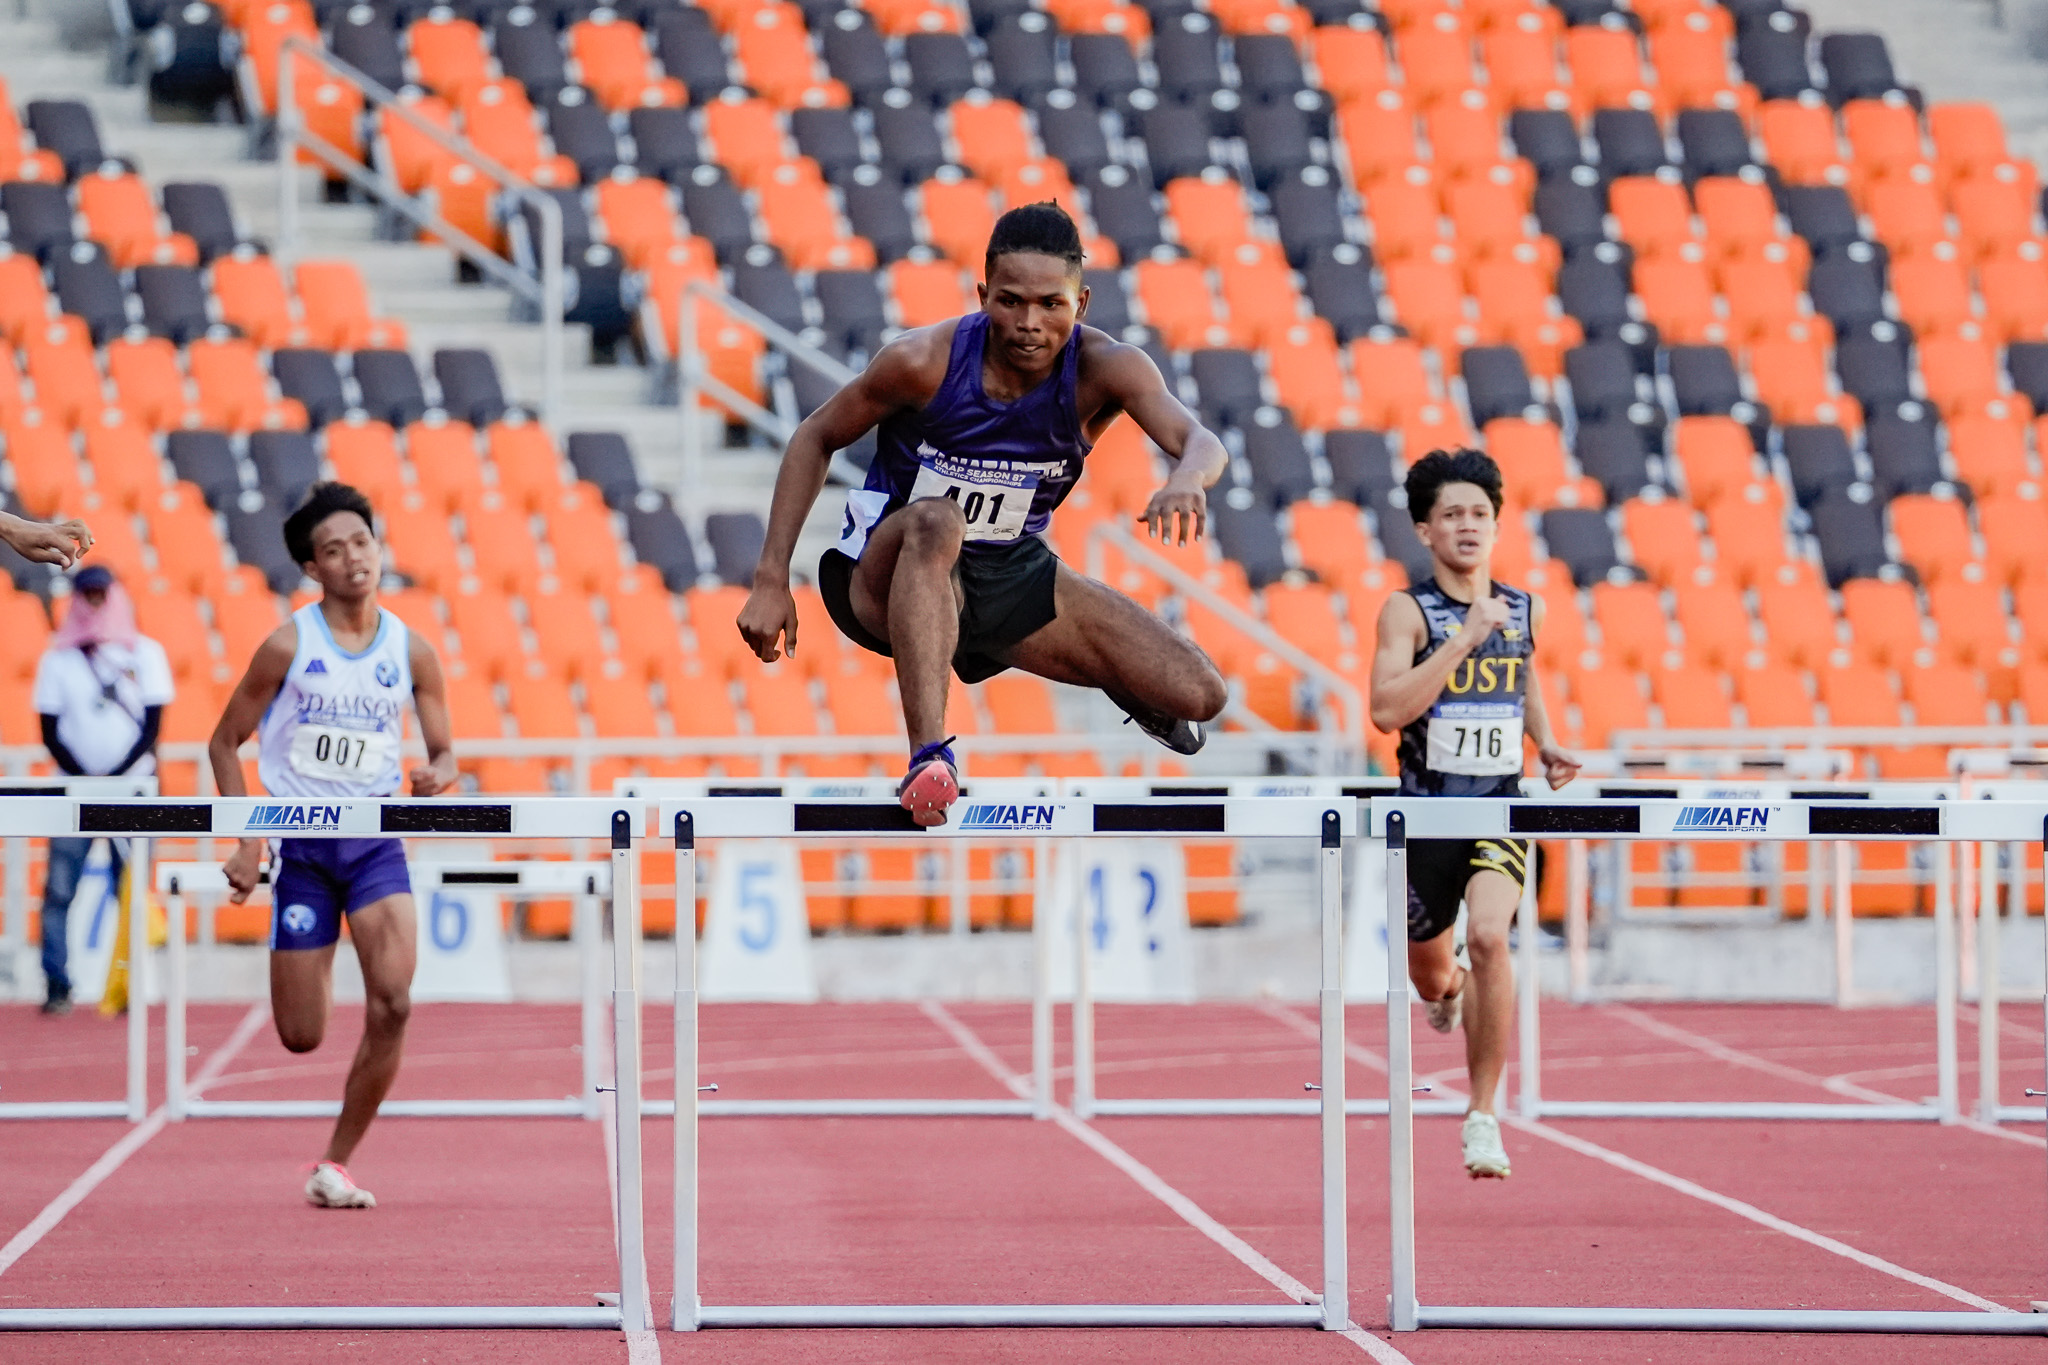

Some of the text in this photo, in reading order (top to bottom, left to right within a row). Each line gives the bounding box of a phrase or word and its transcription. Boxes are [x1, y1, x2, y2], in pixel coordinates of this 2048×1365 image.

[933, 465, 1022, 487] ATHLETICS CHAMPIONSHIPS
[934, 458, 1027, 482] UAAP SEASON 87
[1446, 656, 1524, 694] UST
[316, 734, 366, 769] 007
[1454, 727, 1502, 758] 716
[288, 805, 342, 825] AFN
[1001, 805, 1055, 824] AFN
[1716, 807, 1770, 826] AFN
[739, 864, 777, 951] 5
